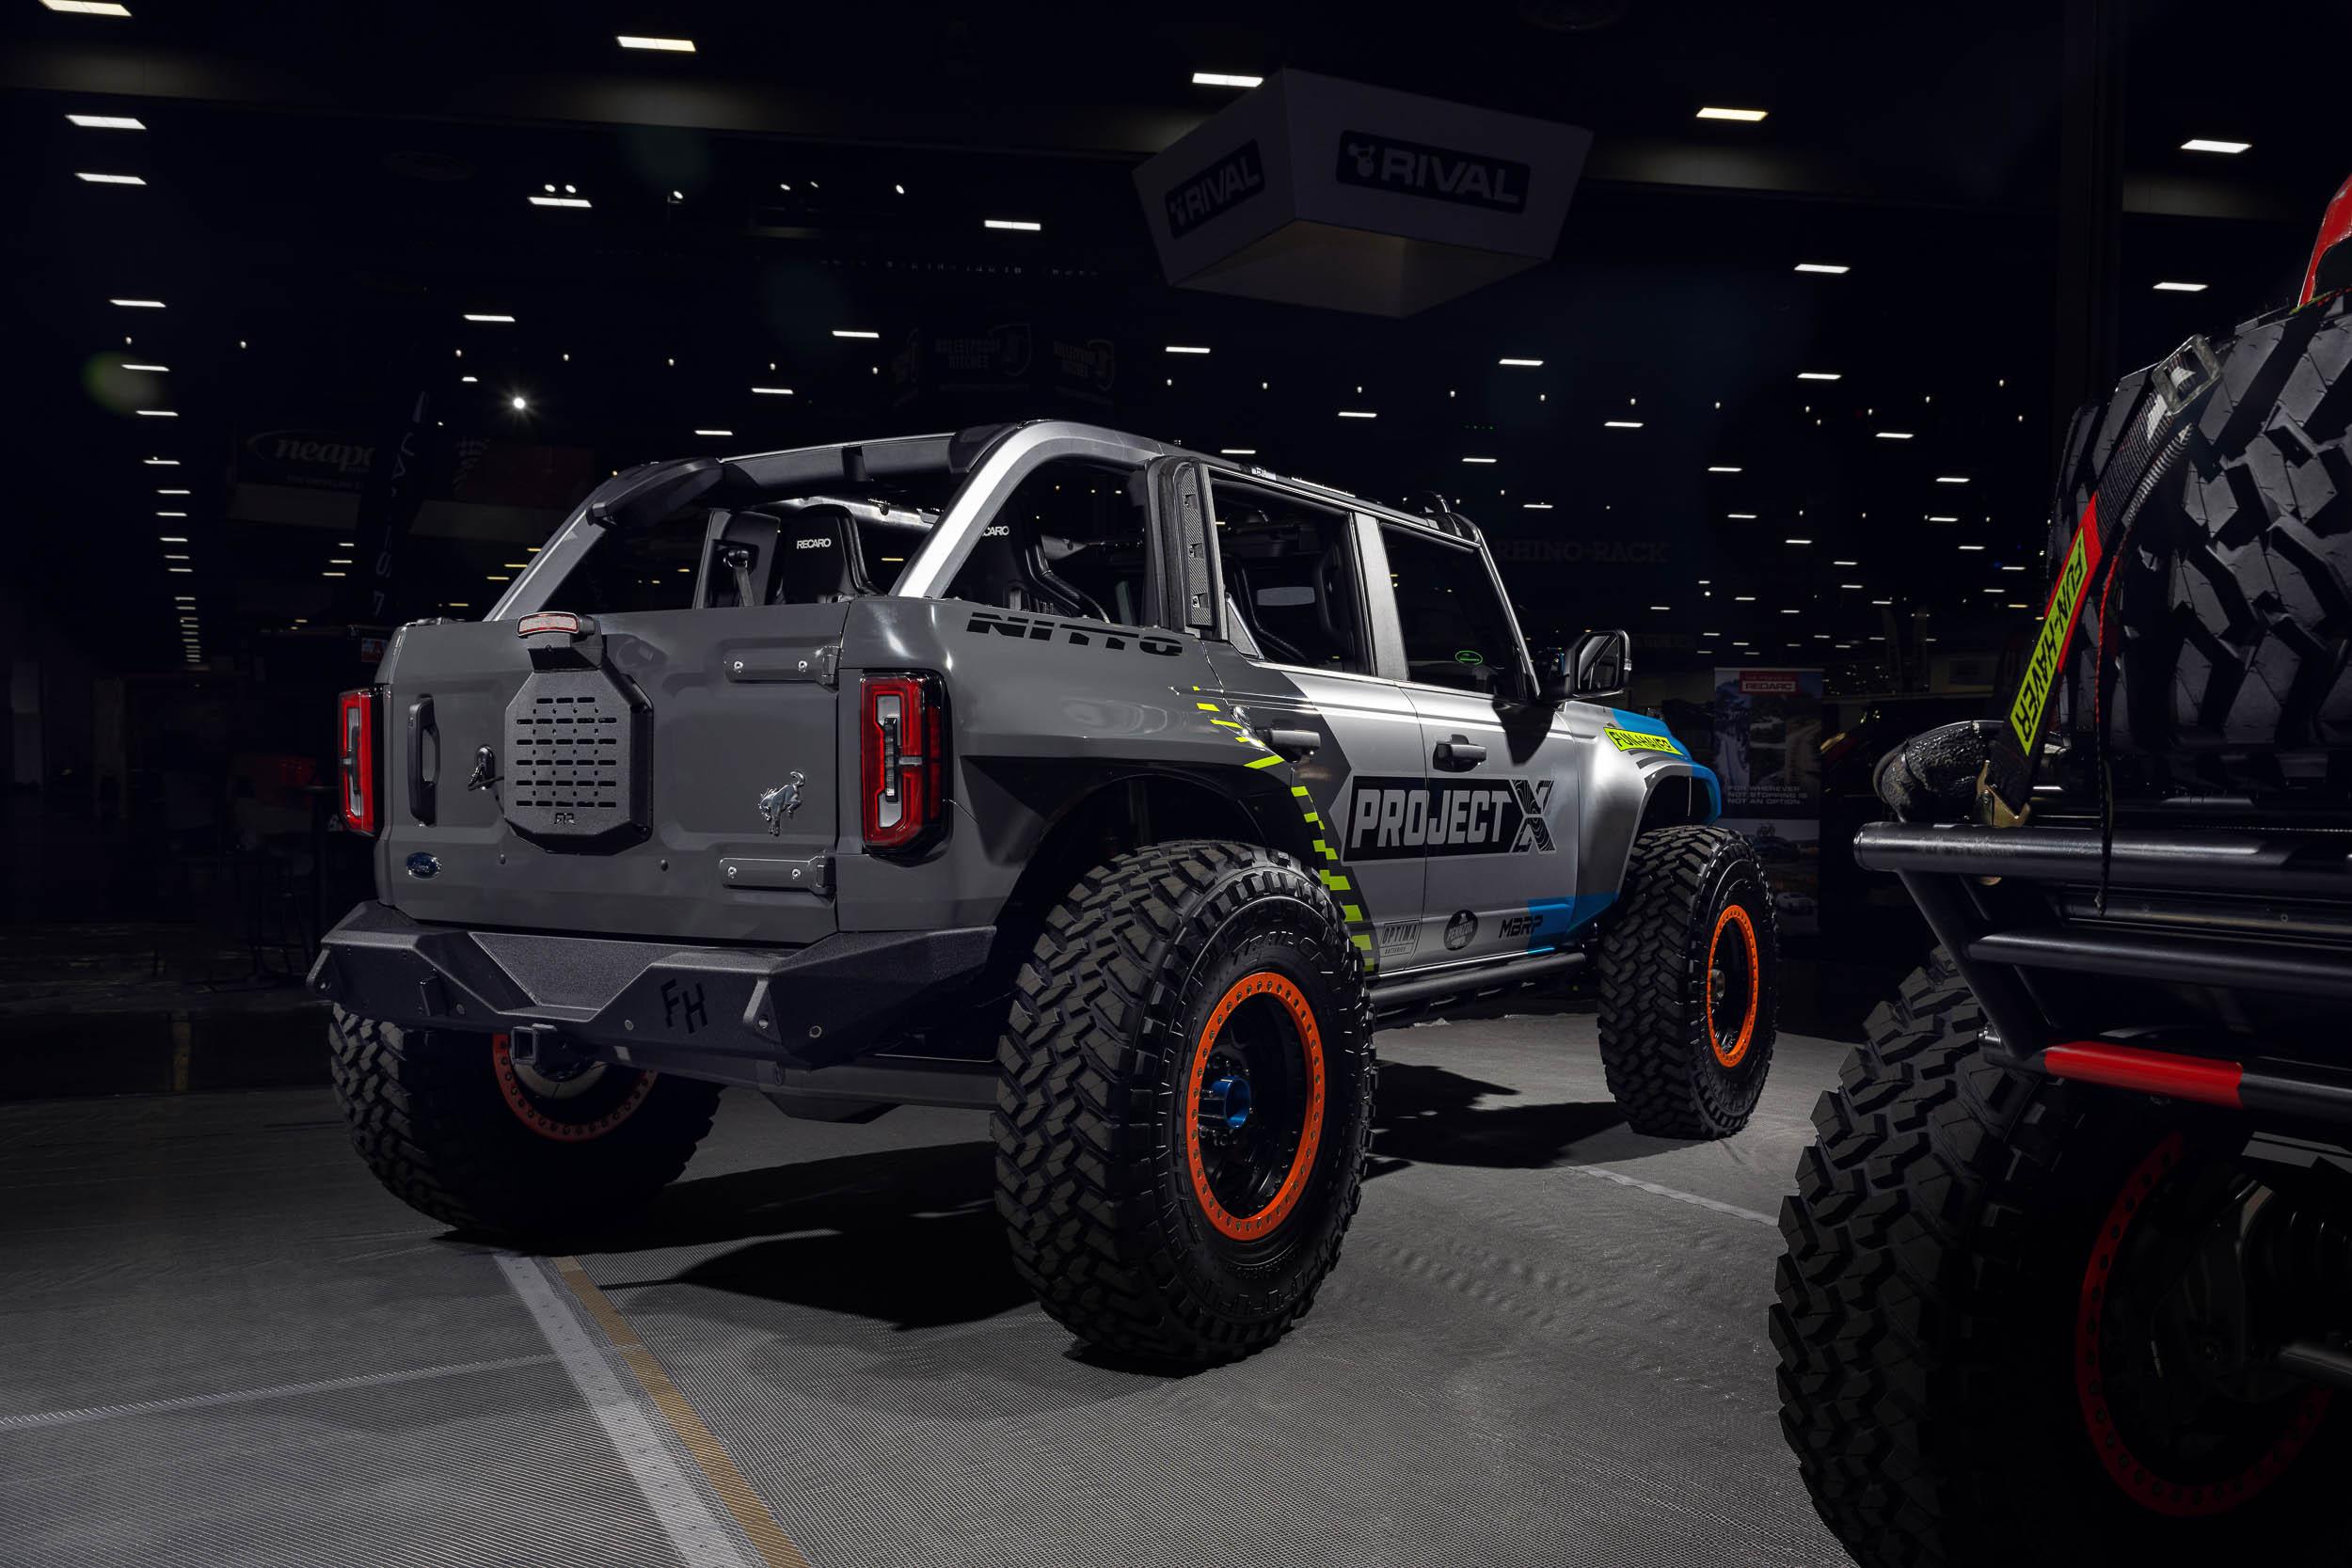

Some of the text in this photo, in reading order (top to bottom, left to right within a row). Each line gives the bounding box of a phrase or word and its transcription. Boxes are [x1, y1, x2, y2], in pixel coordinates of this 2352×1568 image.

[1184, 155, 1261, 222] RIVAL
[1380, 146, 1520, 205] RIVAL
[796, 537, 832, 549] RECARO
[983, 525, 1009, 537] CARO
[965, 611, 1184, 657] NITTO
[2014, 538, 2086, 741] FUN-HAVER
[1350, 779, 1556, 853] PROJECT X
[1382, 924, 1417, 944] OPTIMA
[1498, 915, 1544, 940] MBRP
